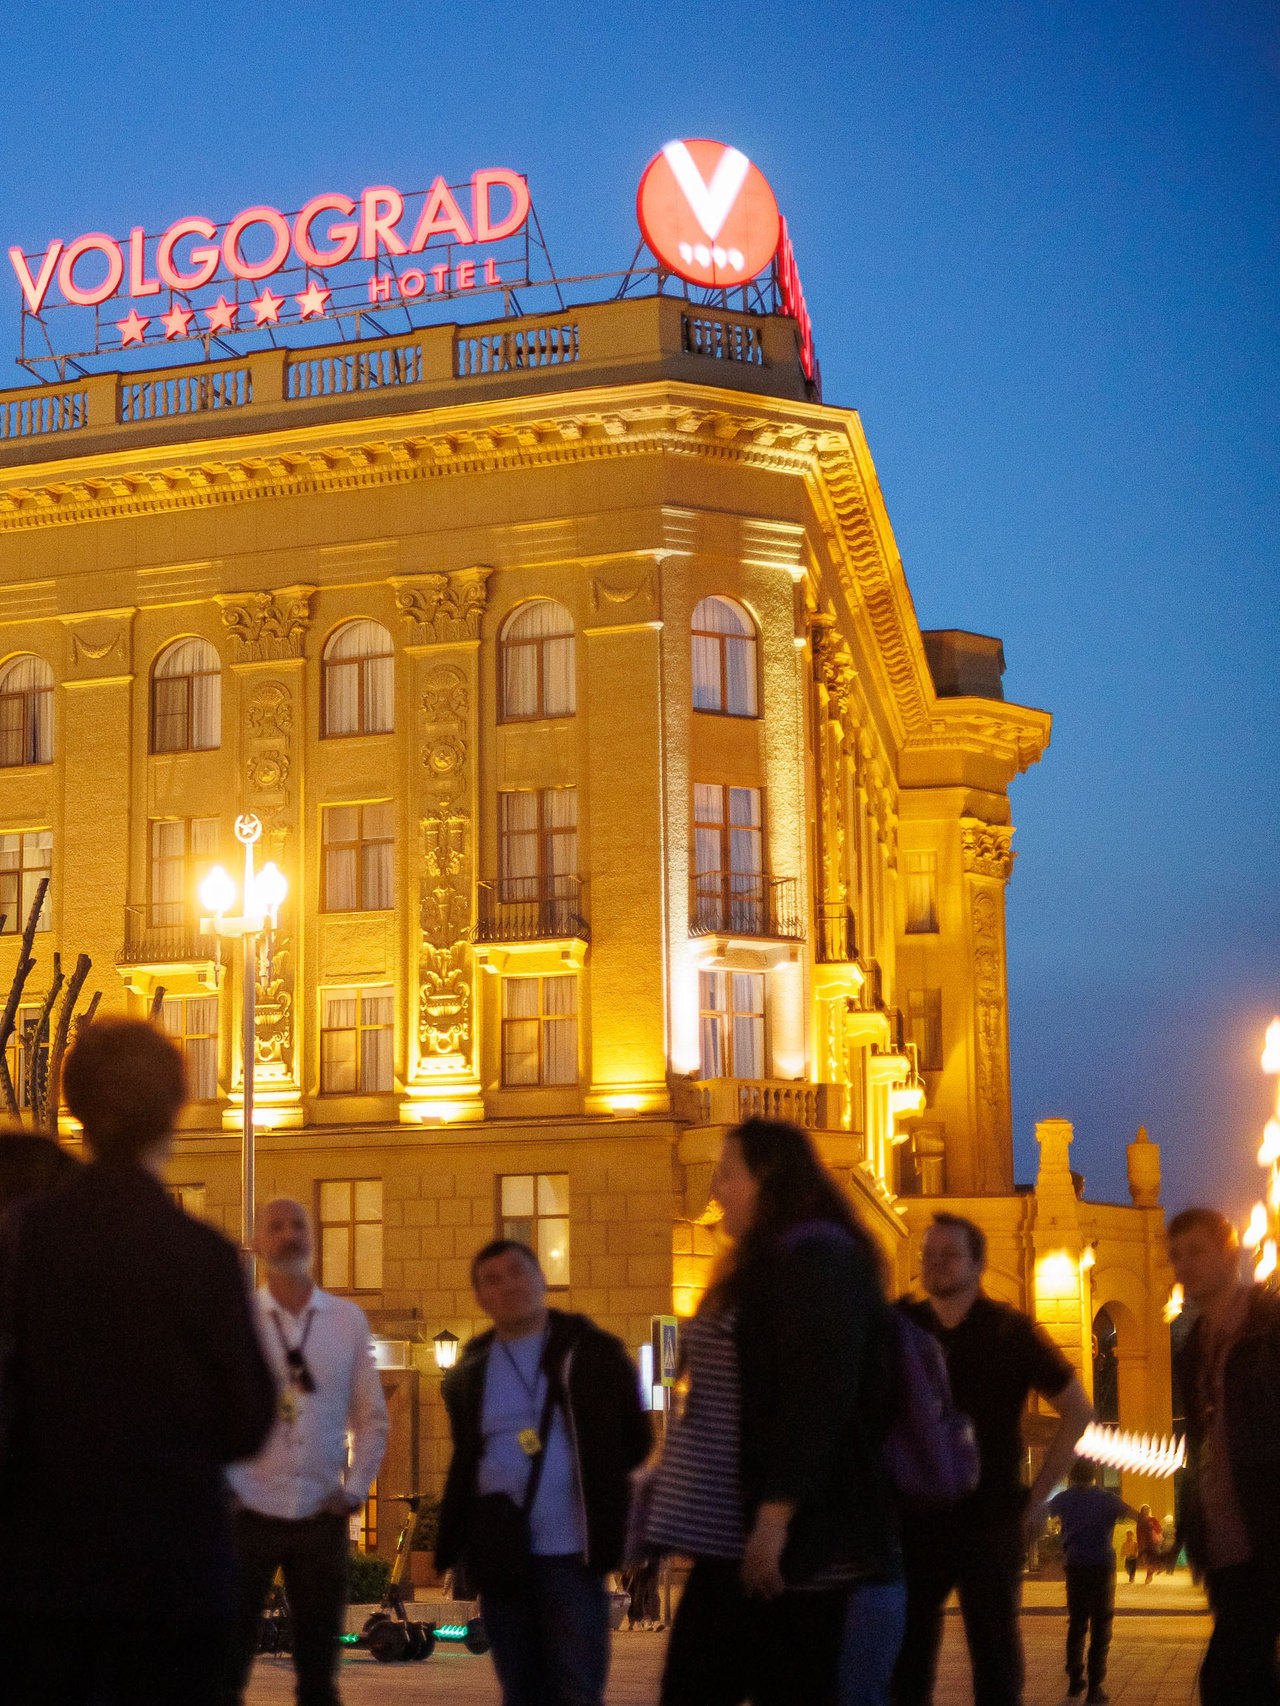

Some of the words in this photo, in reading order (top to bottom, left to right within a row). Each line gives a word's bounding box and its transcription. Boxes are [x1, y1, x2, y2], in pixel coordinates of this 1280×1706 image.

[662, 139, 750, 240] V
[9, 168, 530, 314] VOLGOGRAD
[369, 257, 501, 303] HOTEL
